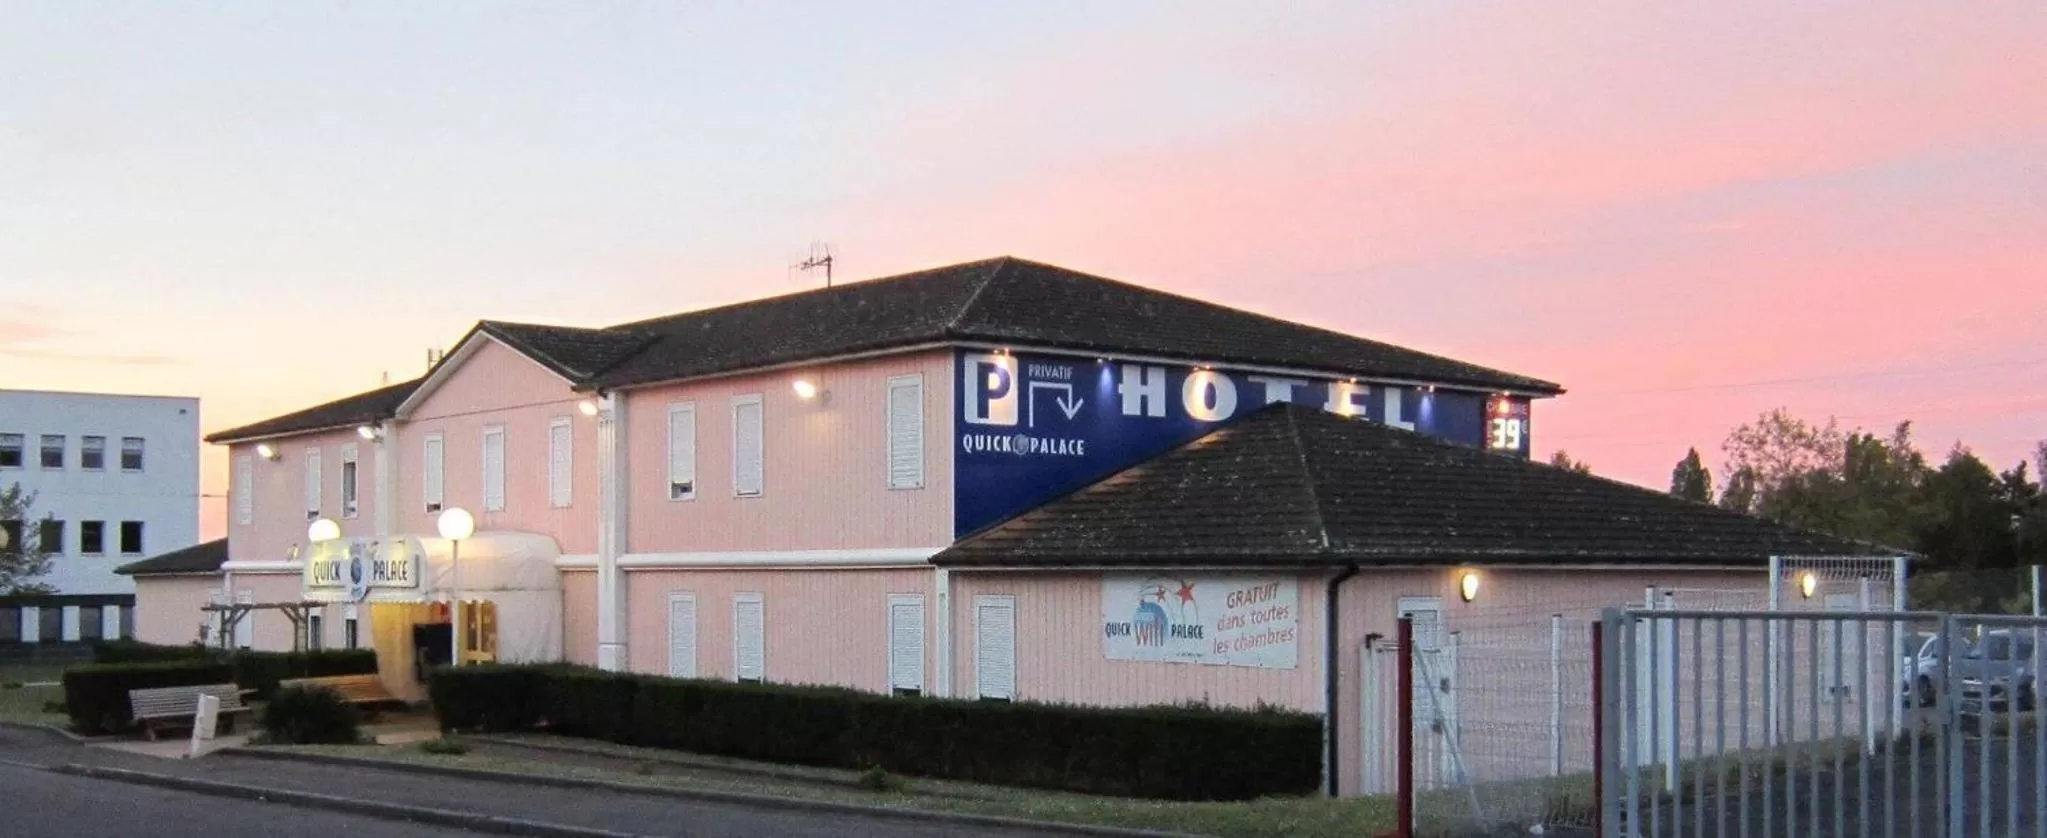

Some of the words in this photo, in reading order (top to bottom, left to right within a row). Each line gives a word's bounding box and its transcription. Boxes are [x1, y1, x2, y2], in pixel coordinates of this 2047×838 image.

[1028, 364, 1073, 380] PRIVATIF
[976, 361, 1011, 419] P
[1118, 364, 1415, 432] HOTEL
[963, 434, 1012, 453] QUICK
[1029, 437, 1085, 455] PALACE
[313, 561, 341, 582] QUICK
[373, 560, 408, 581] PALACE
[1226, 581, 1281, 609] GRATUIT
[1105, 622, 1132, 639] QUICK
[1171, 623, 1204, 640] PALACE
[1216, 614, 1246, 632] dans
[1252, 604, 1290, 624] toutes
[1213, 637, 1229, 655] les
[1233, 626, 1295, 652] chambres
